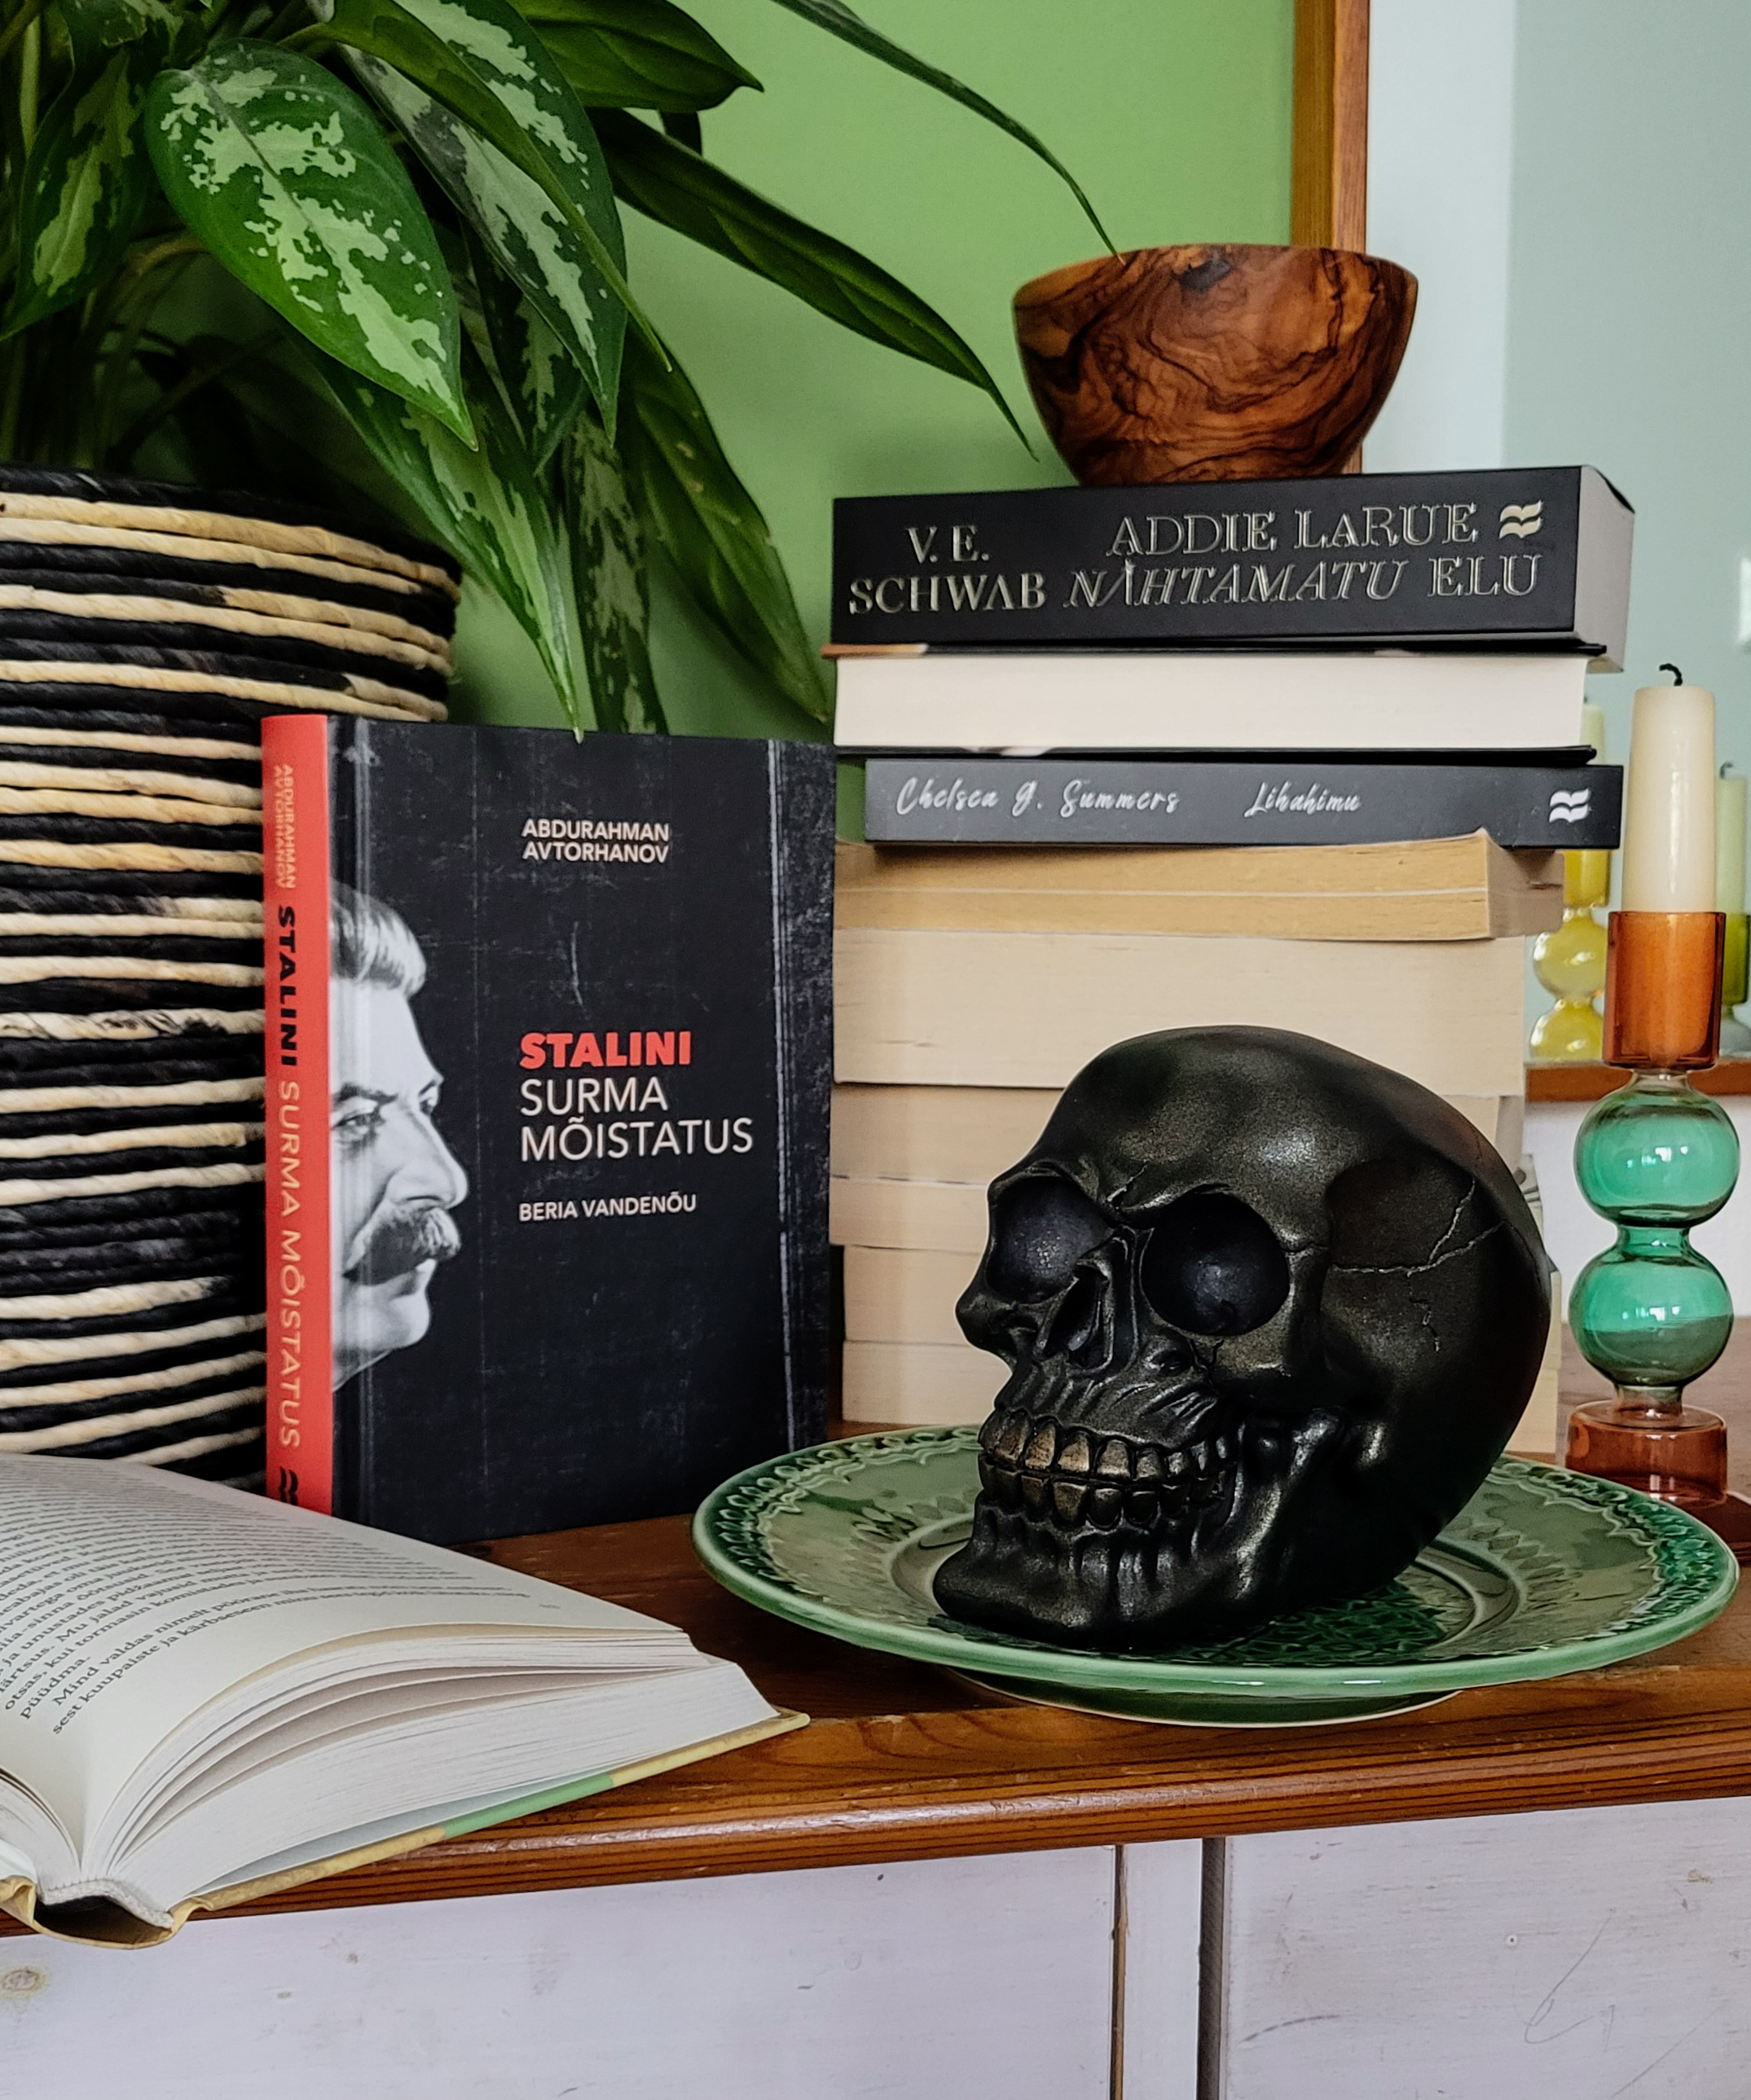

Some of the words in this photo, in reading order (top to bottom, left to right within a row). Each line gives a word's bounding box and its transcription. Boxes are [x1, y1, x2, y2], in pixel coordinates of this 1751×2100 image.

[905, 525, 938, 564] V.
[950, 525, 990, 562] E.
[1106, 510, 1278, 557] ADDIE
[849, 572, 1046, 615] SCHWAB
[1428, 554, 1543, 597] ELU
[896, 777, 999, 815] Chelsea
[1059, 779, 1180, 818] Summers
[1243, 780, 1362, 818] Lihahimu
[521, 818, 670, 841] ABDURAHMAN
[521, 841, 669, 863] AVTORHANOV
[278, 904, 298, 1066] STALINI
[519, 1030, 692, 1070] STALINI
[520, 1076, 669, 1117] SURMA
[279, 1079, 301, 1216] SURMA
[521, 1116, 754, 1162] MÕISTATUS
[519, 1200, 578, 1223] BERIA
[582, 1190, 697, 1219] VANDENÕU
[279, 1229, 306, 1448] MÕISTATUS
[0, 1601, 75, 1653] iia-sinna
[2, 1652, 20, 1668] ja
[21, 1601, 106, 1650] unustades
[55, 1623, 89, 1642] Mu
[89, 1600, 134, 1623] jalad
[5, 1670, 48, 1711] otsas,
[44, 1648, 77, 1668] kui
[75, 1606, 152, 1647] tormasin
[148, 1580, 247, 1607] komistades
[51, 1666, 100, 1707] Mind
[99, 1632, 154, 1666] valdas
[154, 1609, 211, 1634] nimelt
[20, 1656, 92, 1720] püüdma.
[53, 1703, 82, 1735] sest
[79, 1645, 161, 1703] kuupaiste
[159, 1635, 180, 1647] ja
